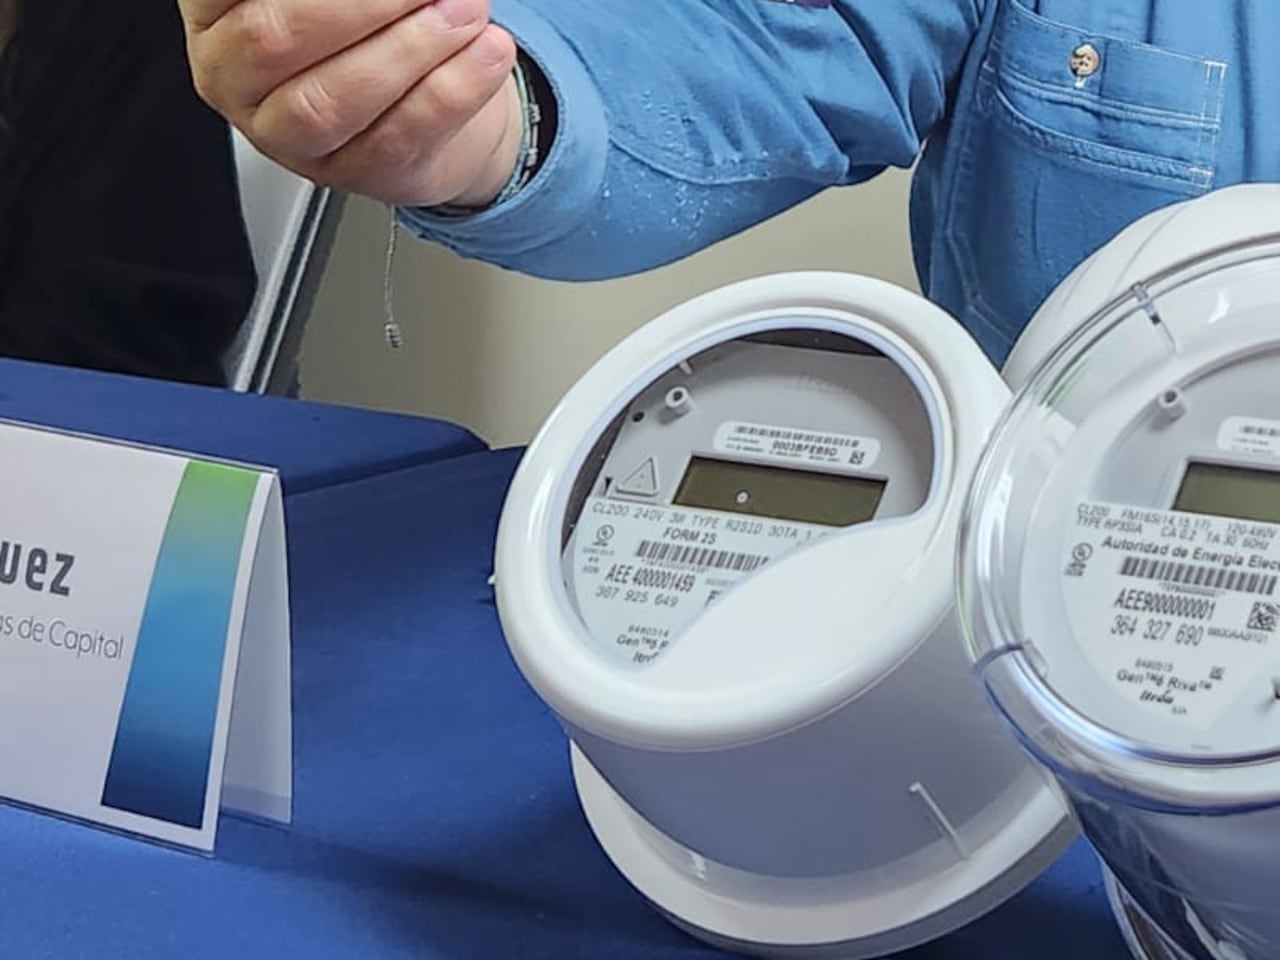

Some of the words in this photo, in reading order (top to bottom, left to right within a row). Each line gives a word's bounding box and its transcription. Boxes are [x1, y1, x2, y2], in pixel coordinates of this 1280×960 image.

[662, 527, 701, 542] FORM
[1101, 535, 1170, 556] Autoridad
[1171, 546, 1189, 559] de
[604, 563, 634, 584] AEE
[18, 616, 45, 642] de
[49, 619, 125, 660] Capital
